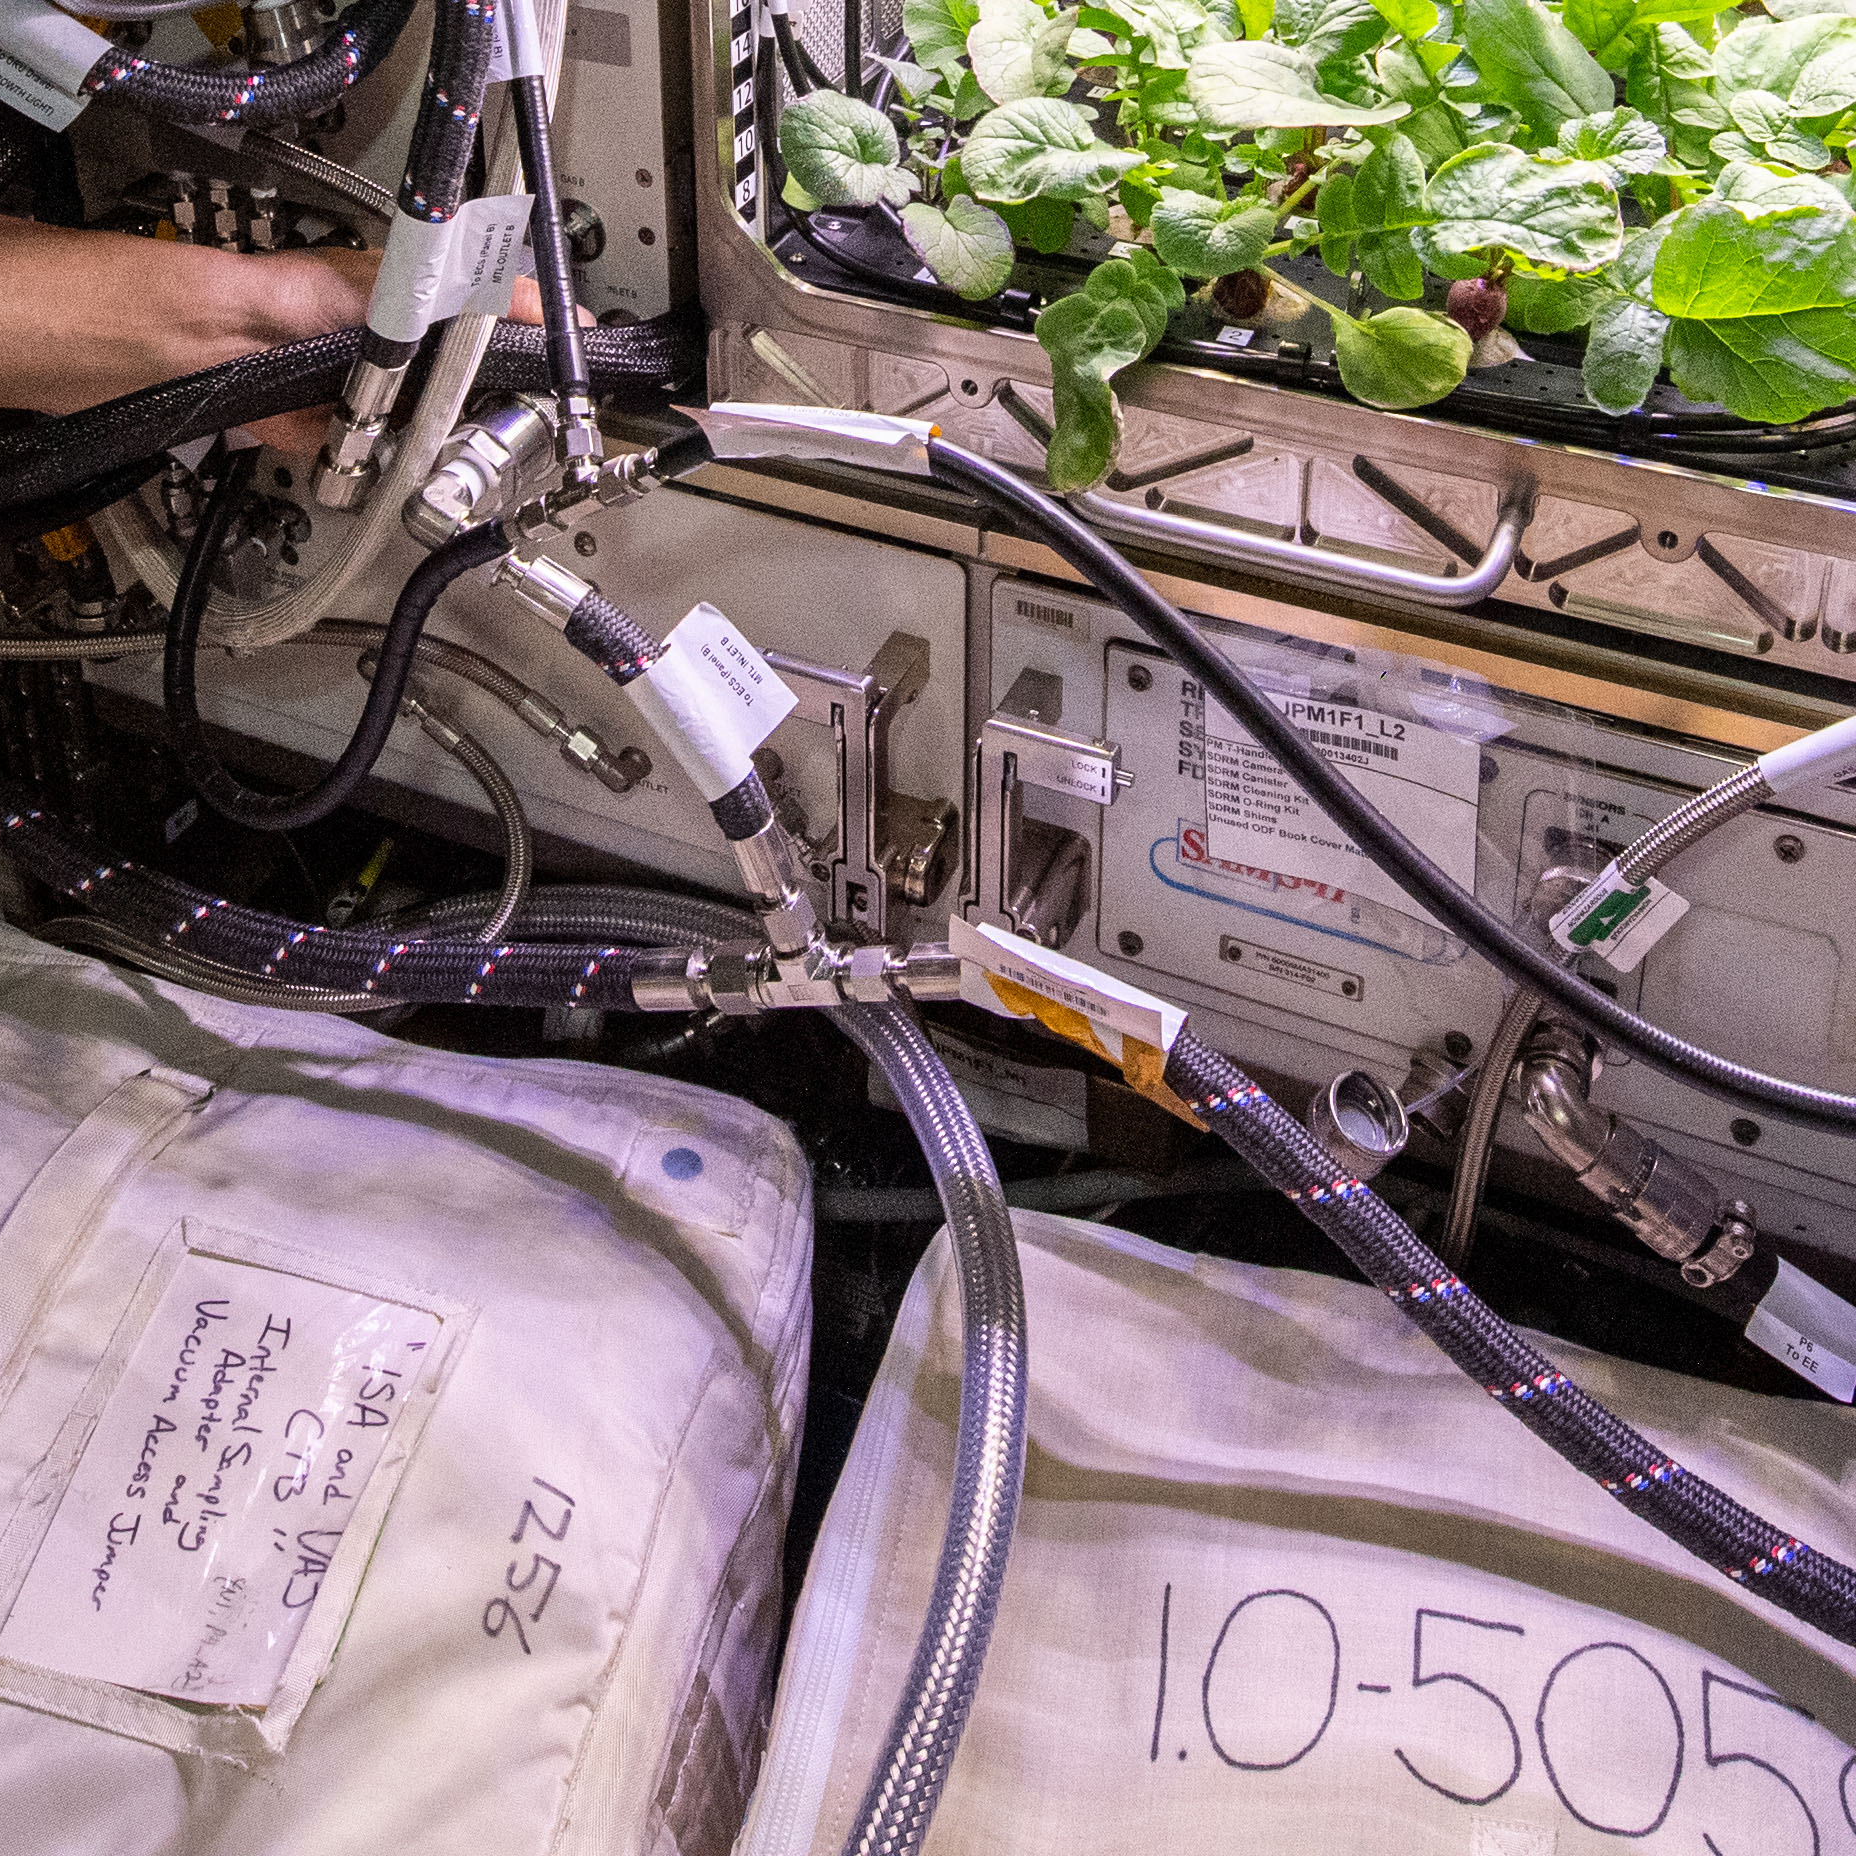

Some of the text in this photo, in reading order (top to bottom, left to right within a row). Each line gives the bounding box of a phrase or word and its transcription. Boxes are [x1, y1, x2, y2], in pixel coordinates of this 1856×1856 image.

[734, 36, 752, 56] 14
[24, 91, 56, 118] LIGHT)
[736, 81, 752, 105] 12
[738, 128, 754, 151] 10
[741, 177, 752, 196] 8
[480, 230, 493, 259] (Panel
[491, 233, 513, 286] MTL OUTLET
[1229, 329, 1244, 342] 2
[725, 643, 764, 685] MTL INLET
[709, 652, 755, 707] To ECS (Panel
[1284, 700, 1407, 743] JPM1F1_L2
[1070, 759, 1098, 775] LOCK
[1206, 750, 1240, 767] SDRM
[1056, 773, 1098, 794] UNLOCK
[1206, 763, 1289, 790] SDRM Canister
[1207, 776, 1292, 804] SDRM Cleaning
[1207, 788, 1301, 817] SDRM O-Ring Kit
[1208, 800, 1278, 825] SDRM Shims
[1208, 812, 1344, 852] Unused ODF Book Cover
[1785, 1343, 1821, 1376] To EE
[1798, 1335, 1815, 1355] P6
[231, 1313, 292, 1436] Internal
[161, 1348, 246, 1527] Adapter and
[92, 1299, 231, 1613] Vacuum Access Jumper
[322, 1447, 354, 1507] and
[177, 1441, 253, 1553] Sampling
[281, 1529, 344, 1610] VAJ
[480, 1476, 577, 1656] 1256
